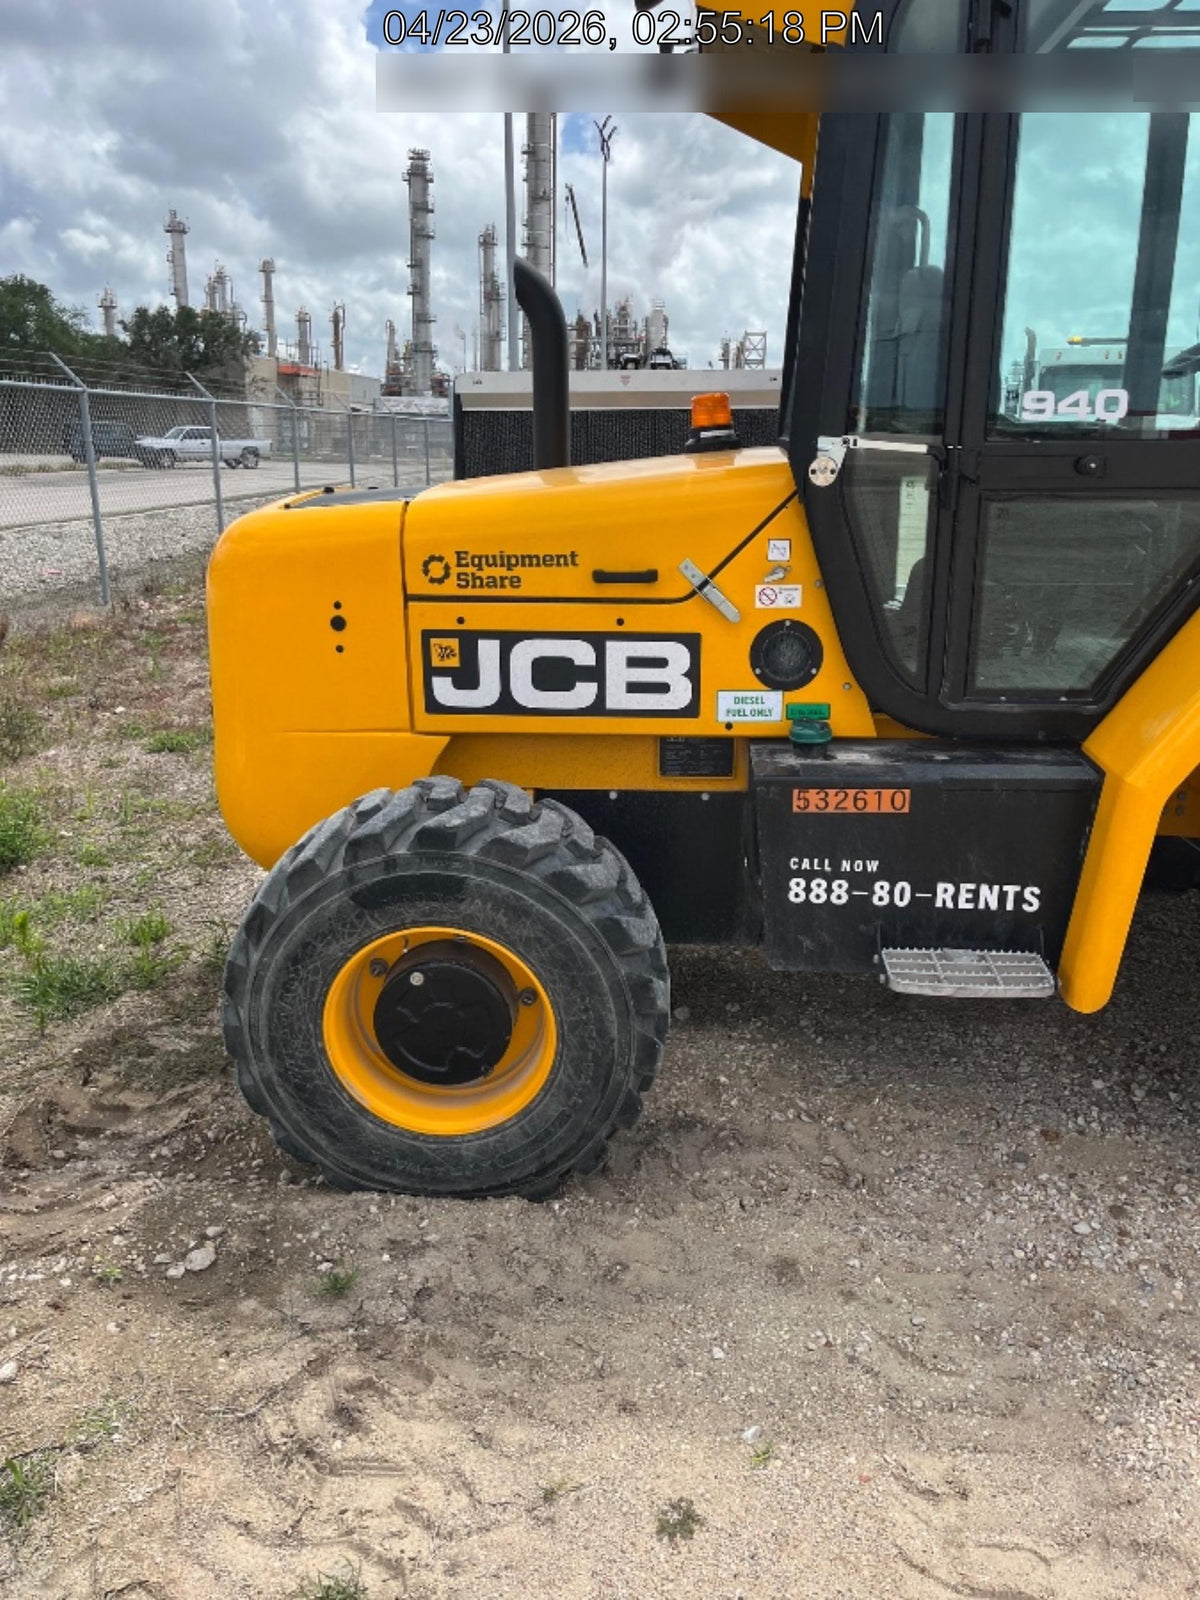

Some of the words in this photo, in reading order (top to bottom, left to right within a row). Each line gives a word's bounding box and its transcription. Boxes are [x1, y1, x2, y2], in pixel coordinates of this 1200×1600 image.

[1022, 388, 1129, 421] 940
[455, 551, 579, 571] Equipment
[456, 572, 522, 589] Share
[431, 638, 693, 711] JCB
[733, 696, 765, 705] DIESEL
[726, 708, 749, 717] FUEL
[750, 708, 774, 717] ONLY
[795, 790, 906, 811] 532610
[789, 857, 832, 872] CALL
[840, 859, 880, 873] NOW
[787, 877, 1042, 913] 888-80-RENTS
